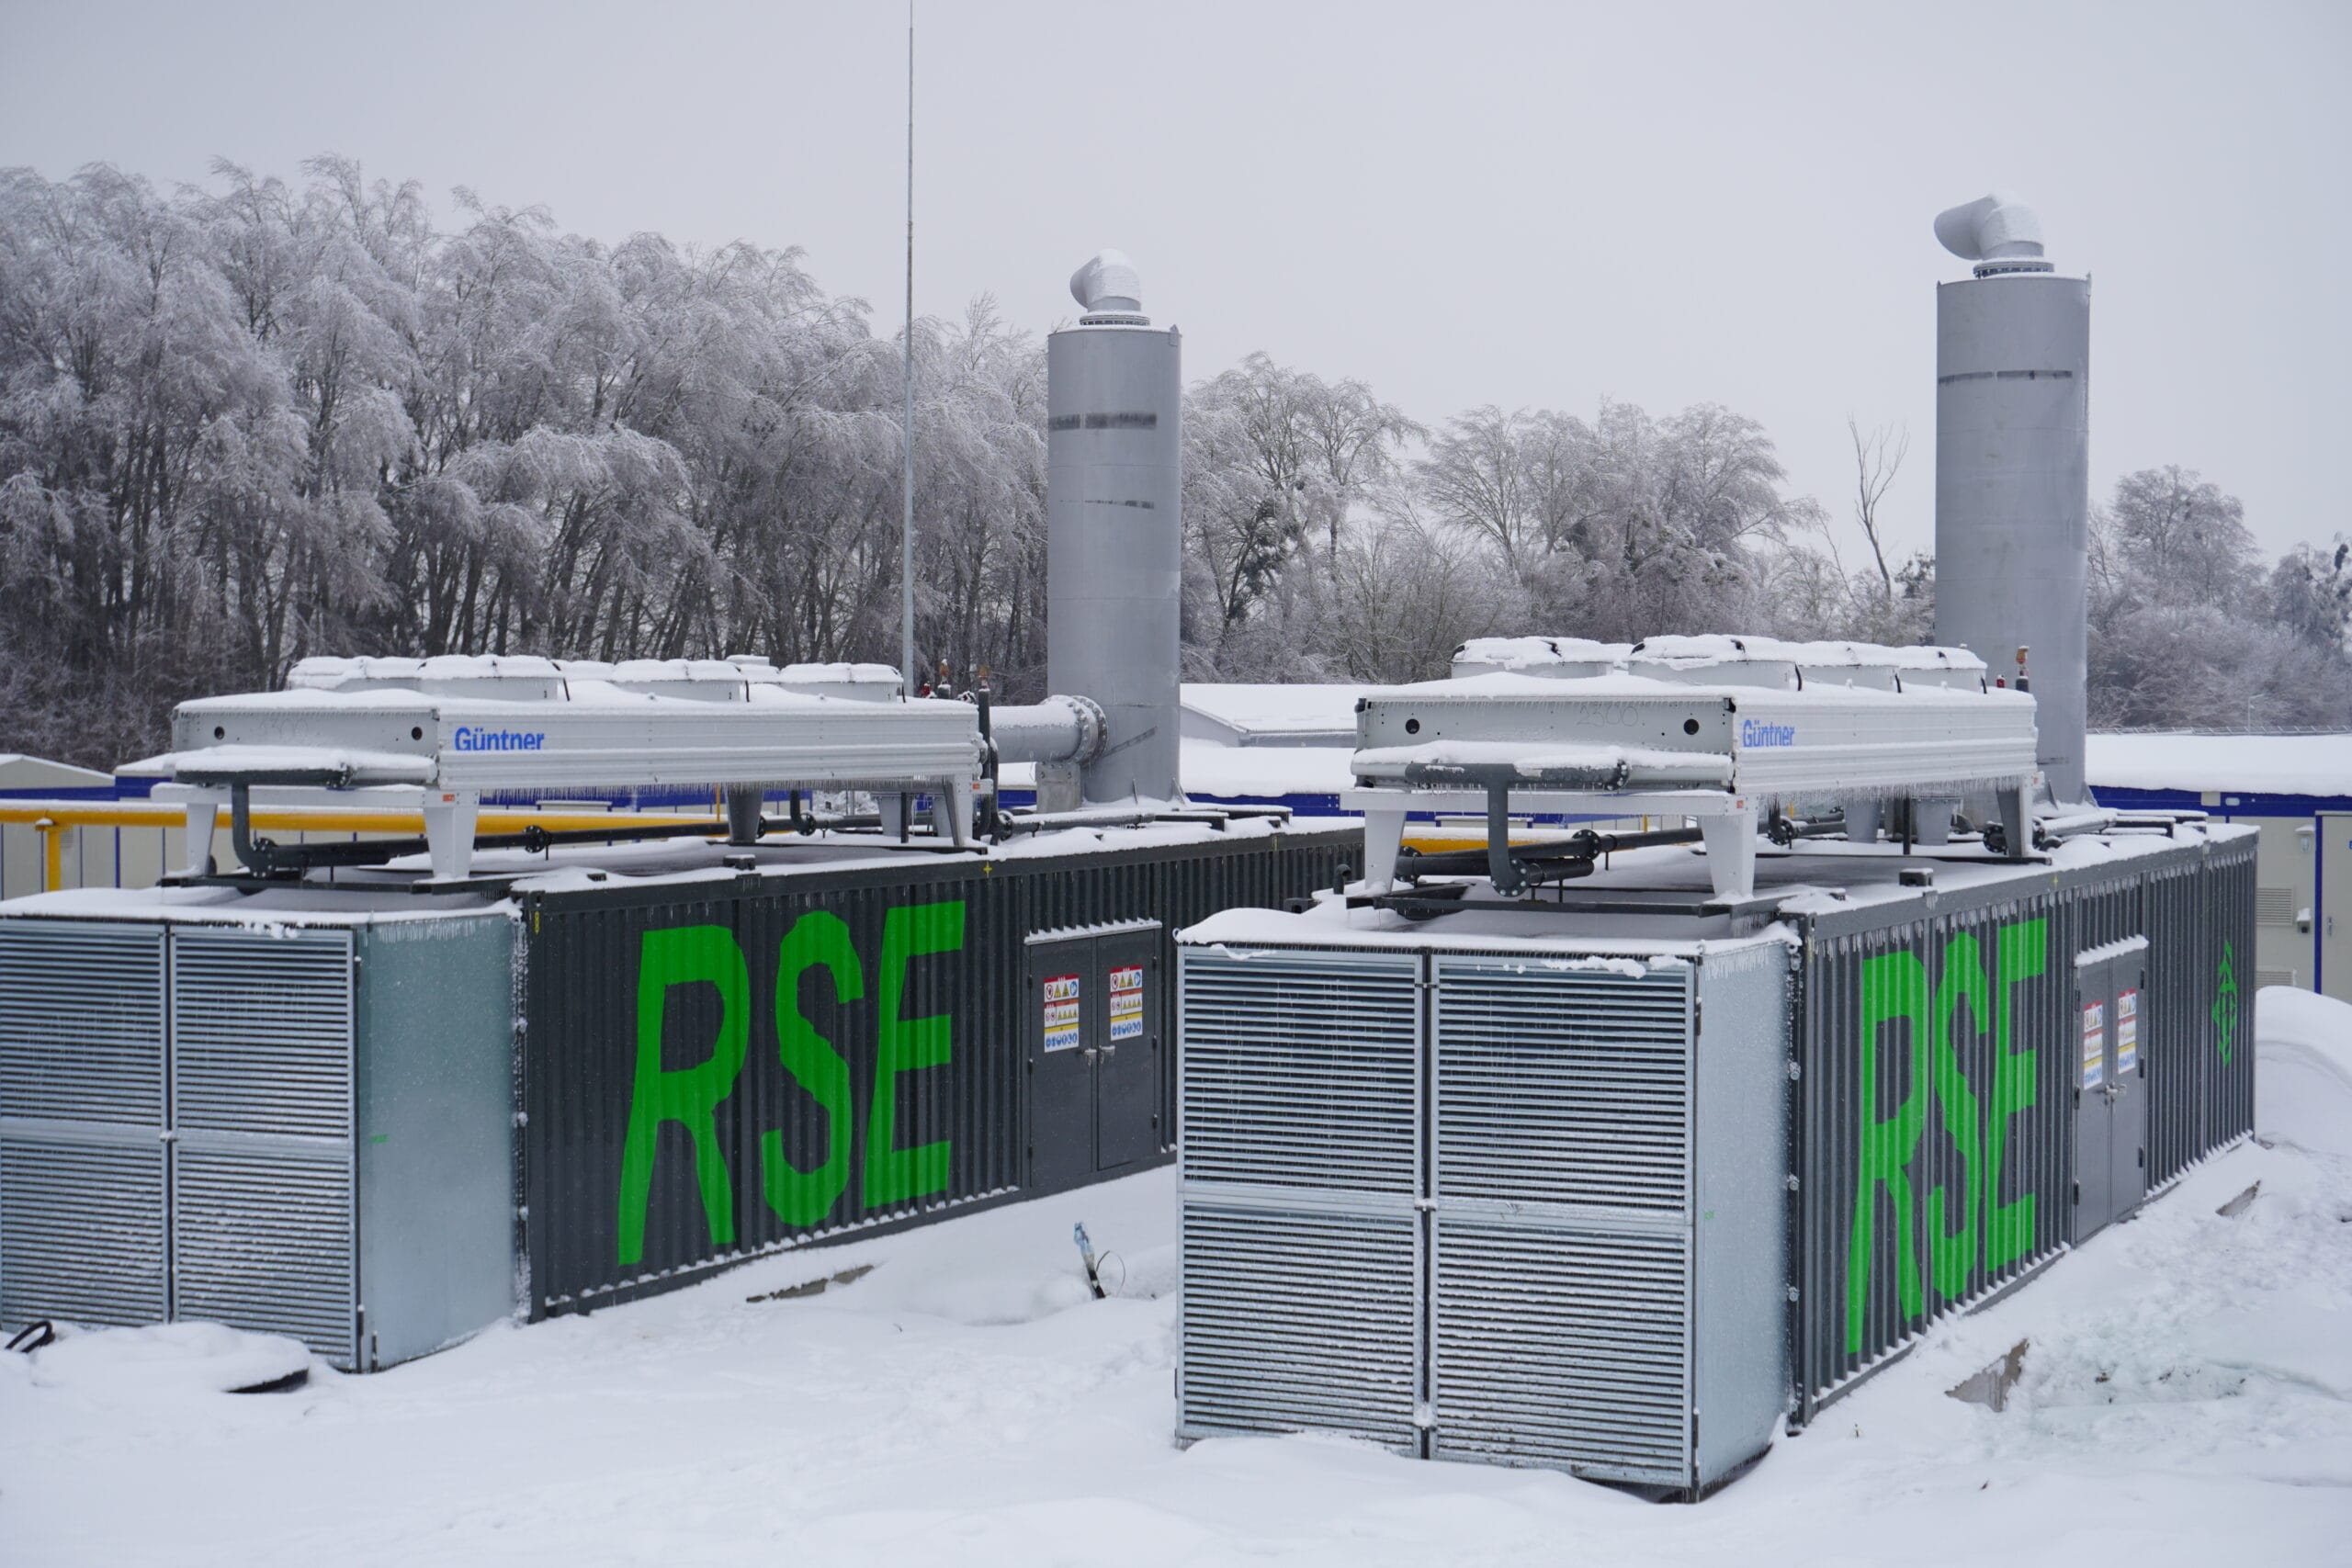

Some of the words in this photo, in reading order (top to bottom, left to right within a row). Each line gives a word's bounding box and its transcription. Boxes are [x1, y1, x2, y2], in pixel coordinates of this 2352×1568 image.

[454, 727, 545, 751] Güntner
[1742, 719, 1795, 748] Güntner
[617, 899, 966, 1266] RSE
[1847, 918, 2047, 1354] RSE
